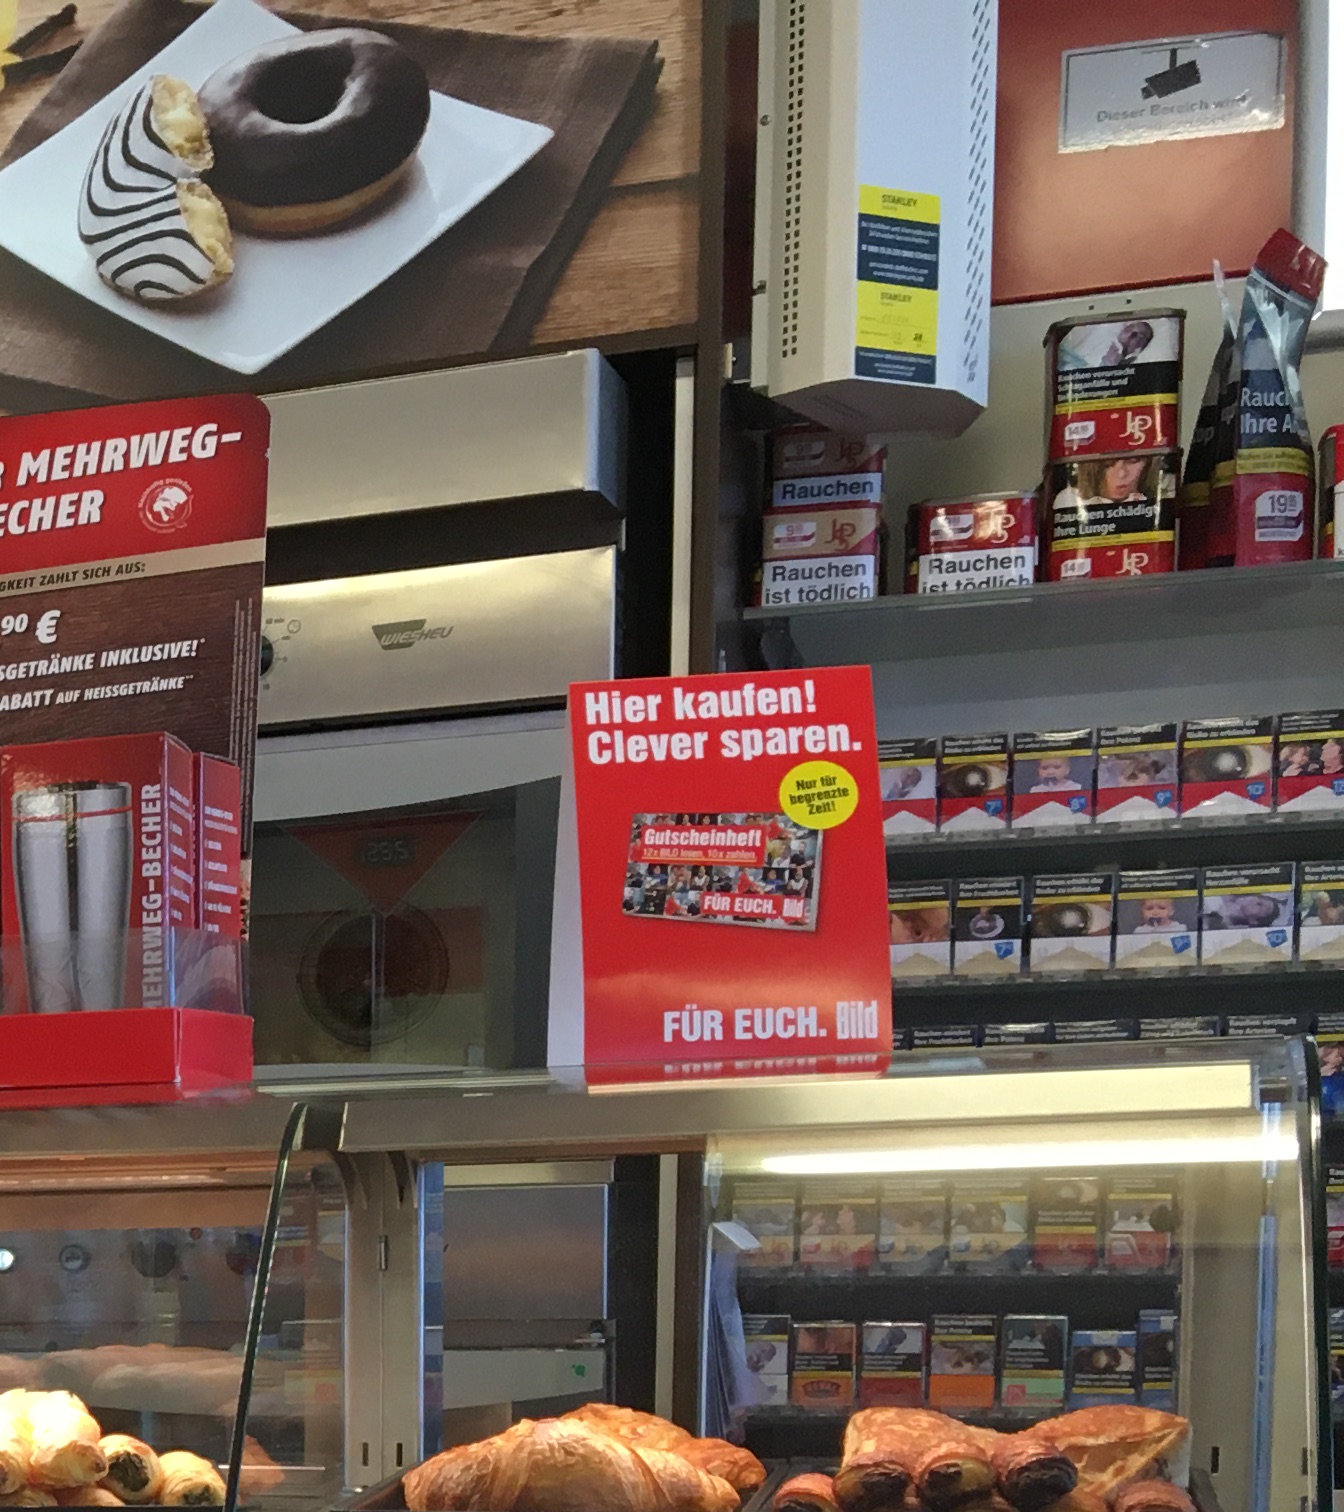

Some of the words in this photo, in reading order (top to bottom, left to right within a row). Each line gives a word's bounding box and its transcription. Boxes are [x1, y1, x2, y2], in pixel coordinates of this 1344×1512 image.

[1240, 413, 1277, 434] Ihre
[16, 423, 242, 487] MEHRWEG-
[782, 478, 873, 500] Rauchen
[1079, 522, 1116, 536] Lunge
[39, 570, 79, 587] ZAHLT
[82, 566, 112, 581] SICH
[115, 561, 146, 577] AUS:
[772, 562, 867, 582] Rauchen
[929, 553, 1026, 575] Rauchen
[765, 589, 790, 605] ist
[798, 582, 870, 603] tödlich
[35, 610, 61, 644] €
[380, 626, 454, 646] WIESHEU
[55, 690, 81, 705] AUF
[585, 689, 661, 725] Hier
[673, 680, 816, 720] kaufen!
[589, 730, 708, 765] Clever
[720, 723, 863, 761] sparen.
[796, 778, 816, 791] Nur
[820, 775, 838, 787] für
[789, 786, 850, 806] begrenzte
[807, 801, 837, 815] Zeit!
[644, 828, 761, 847] Gutscheinheft
[141, 784, 163, 1007] EHRWEG-BECHER
[704, 893, 731, 913] FÜR
[734, 896, 776, 914] EUCH.
[664, 1003, 724, 1042] FÜR
[734, 1006, 827, 1041] EUCH.
[836, 1000, 878, 1039] Bild
